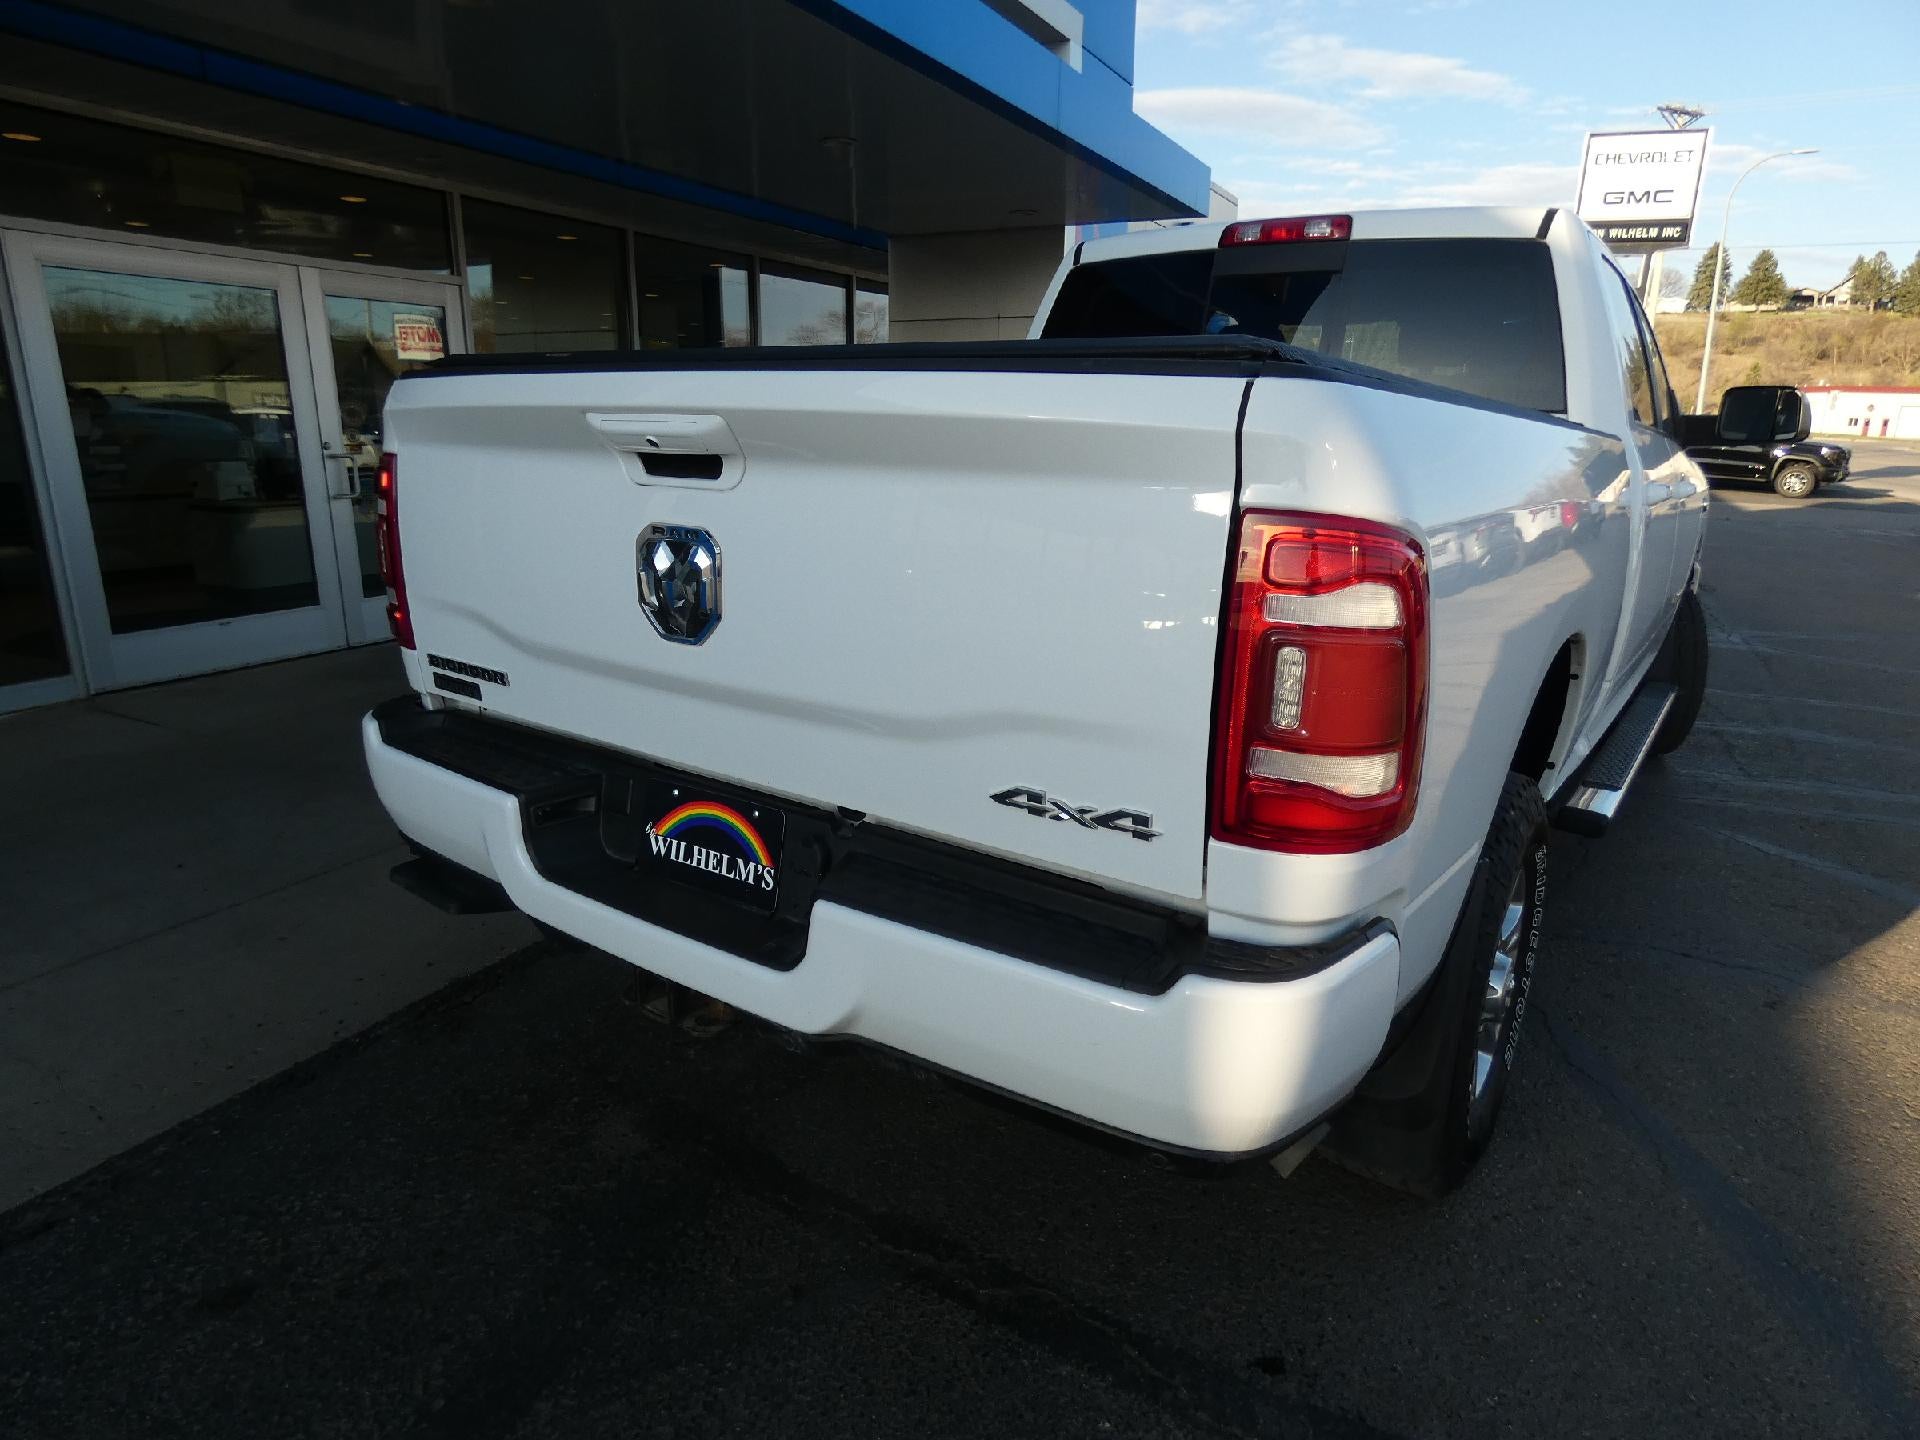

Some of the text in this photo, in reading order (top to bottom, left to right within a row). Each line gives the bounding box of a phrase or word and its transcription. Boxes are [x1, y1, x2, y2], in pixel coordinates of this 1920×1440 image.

[1594, 150, 1694, 166] CHEVROLET
[1603, 189, 1674, 205] GMC
[1609, 227, 1659, 239] WILHELM
[1662, 226, 1682, 239] INC
[650, 834, 775, 891] WILHELM'S
